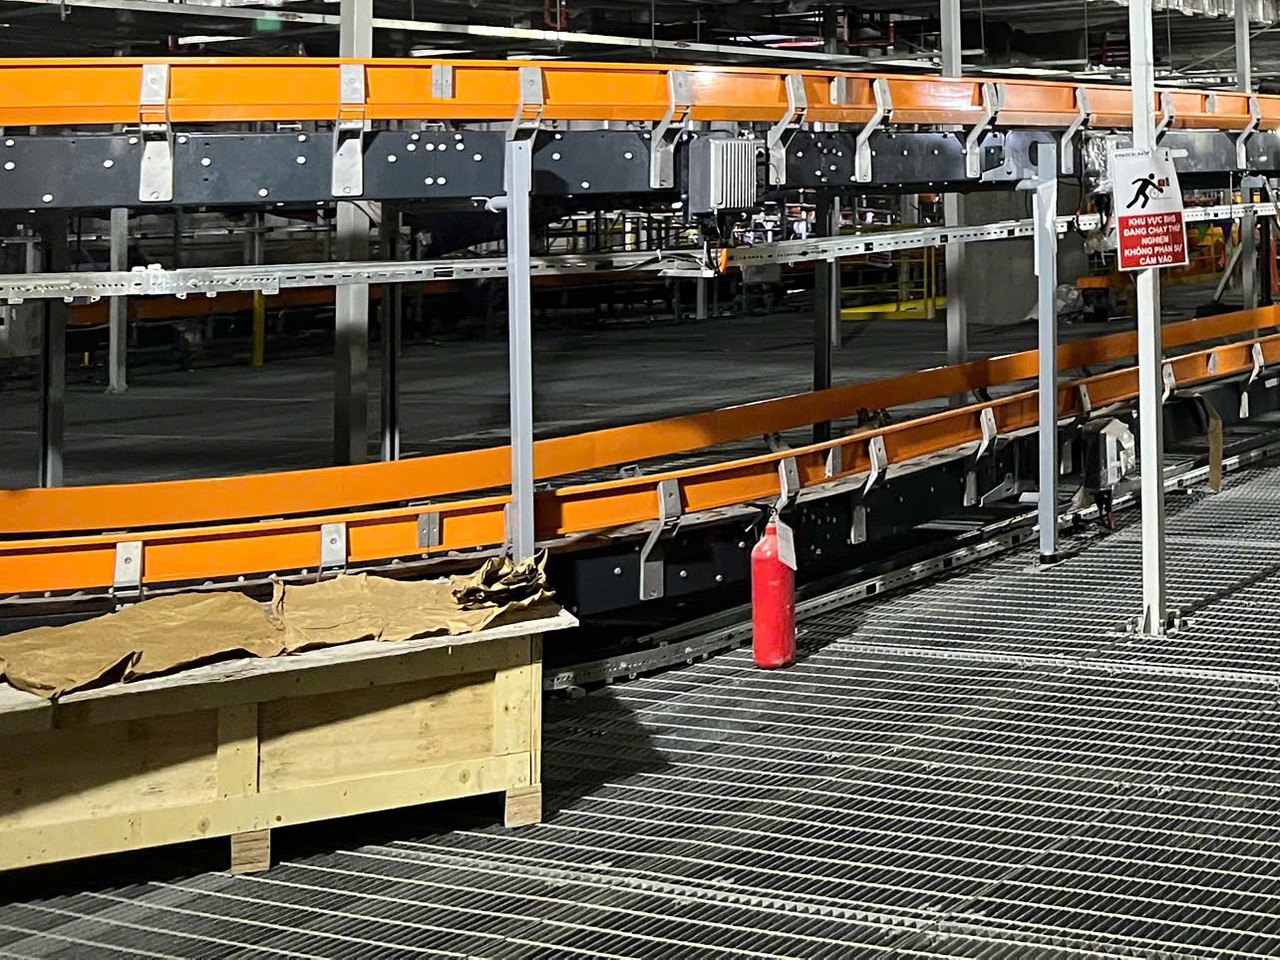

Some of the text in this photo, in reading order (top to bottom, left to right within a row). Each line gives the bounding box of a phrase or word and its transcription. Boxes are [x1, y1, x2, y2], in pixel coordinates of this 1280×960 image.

[1129, 217, 1145, 226] KHU
[1123, 227, 1147, 236] ĐANG
[1124, 246, 1153, 256] KHÔNG
